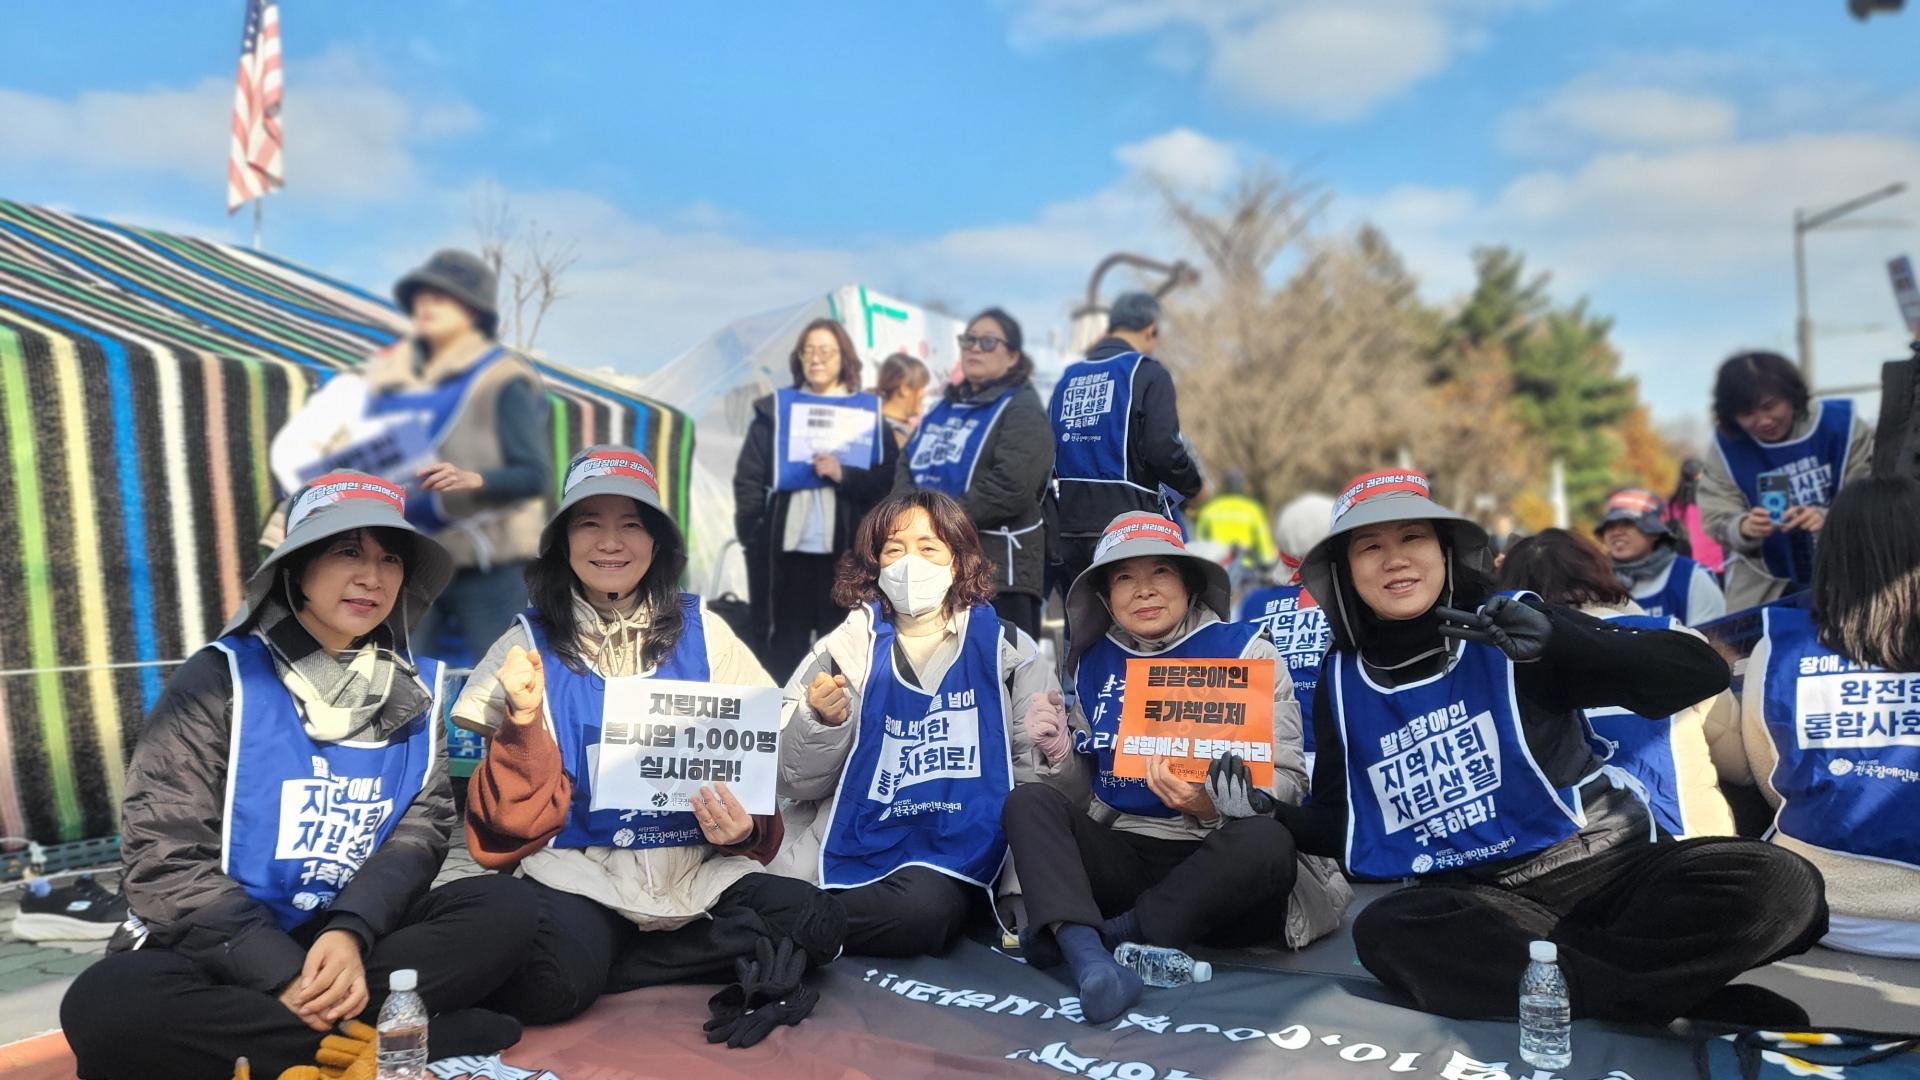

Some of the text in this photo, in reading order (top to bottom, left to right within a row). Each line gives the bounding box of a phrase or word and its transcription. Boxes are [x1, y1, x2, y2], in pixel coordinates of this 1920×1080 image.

[1065, 382, 1108, 403] 지역사회
[1063, 398, 1106, 419] 자립생활
[1366, 475, 1404, 489] 권리예산
[1148, 666, 1248, 689] 발달장애인
[648, 692, 741, 721] 자립지원
[947, 688, 975, 708] 넘어
[1144, 700, 1247, 726] 국가책임제
[604, 721, 777, 754] 본사업 1,000명
[1379, 699, 1468, 758] 발달장애인
[1122, 735, 1190, 758] 실행예산
[1193, 738, 1272, 763] 보장하라
[1379, 722, 1487, 794] 지역사회
[639, 755, 742, 783] 실시하라!
[1390, 753, 1499, 824] 자립생활
[1414, 794, 1496, 847] 구축하라!
